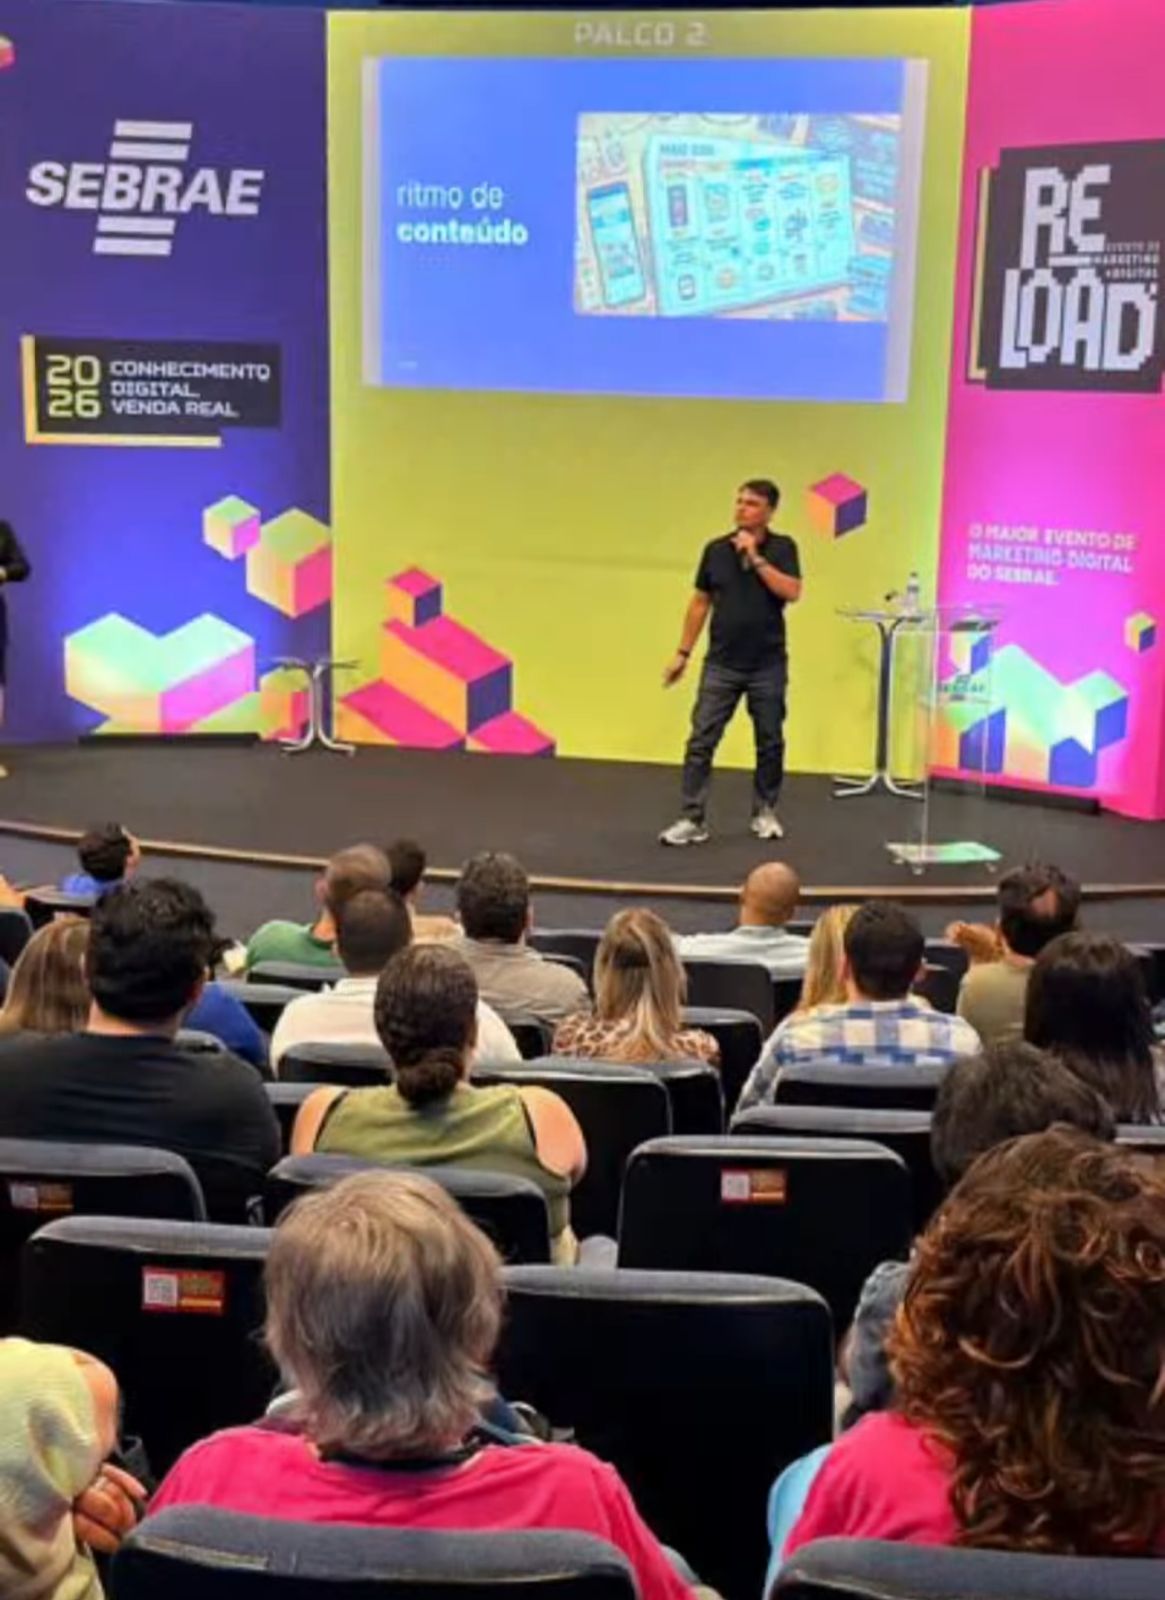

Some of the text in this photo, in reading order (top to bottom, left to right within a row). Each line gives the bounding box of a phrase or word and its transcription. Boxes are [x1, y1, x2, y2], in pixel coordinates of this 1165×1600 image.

[575, 21, 707, 47] PALCO 2
[26, 161, 265, 215] SEBRAE
[397, 181, 504, 210] ritmo de
[1020, 164, 1111, 269] RE
[397, 217, 529, 247] conteúdo
[1000, 269, 1158, 371] LOAD
[46, 355, 101, 386] 20
[110, 360, 270, 382] CONHECIMENTO
[48, 388, 101, 418] 26
[112, 399, 180, 415] VENDA
[985, 524, 1039, 542] MAIOR
[1045, 529, 1110, 548] EVENTO
[1113, 533, 1136, 550] DE
[1067, 551, 1132, 573] DIGITAL
